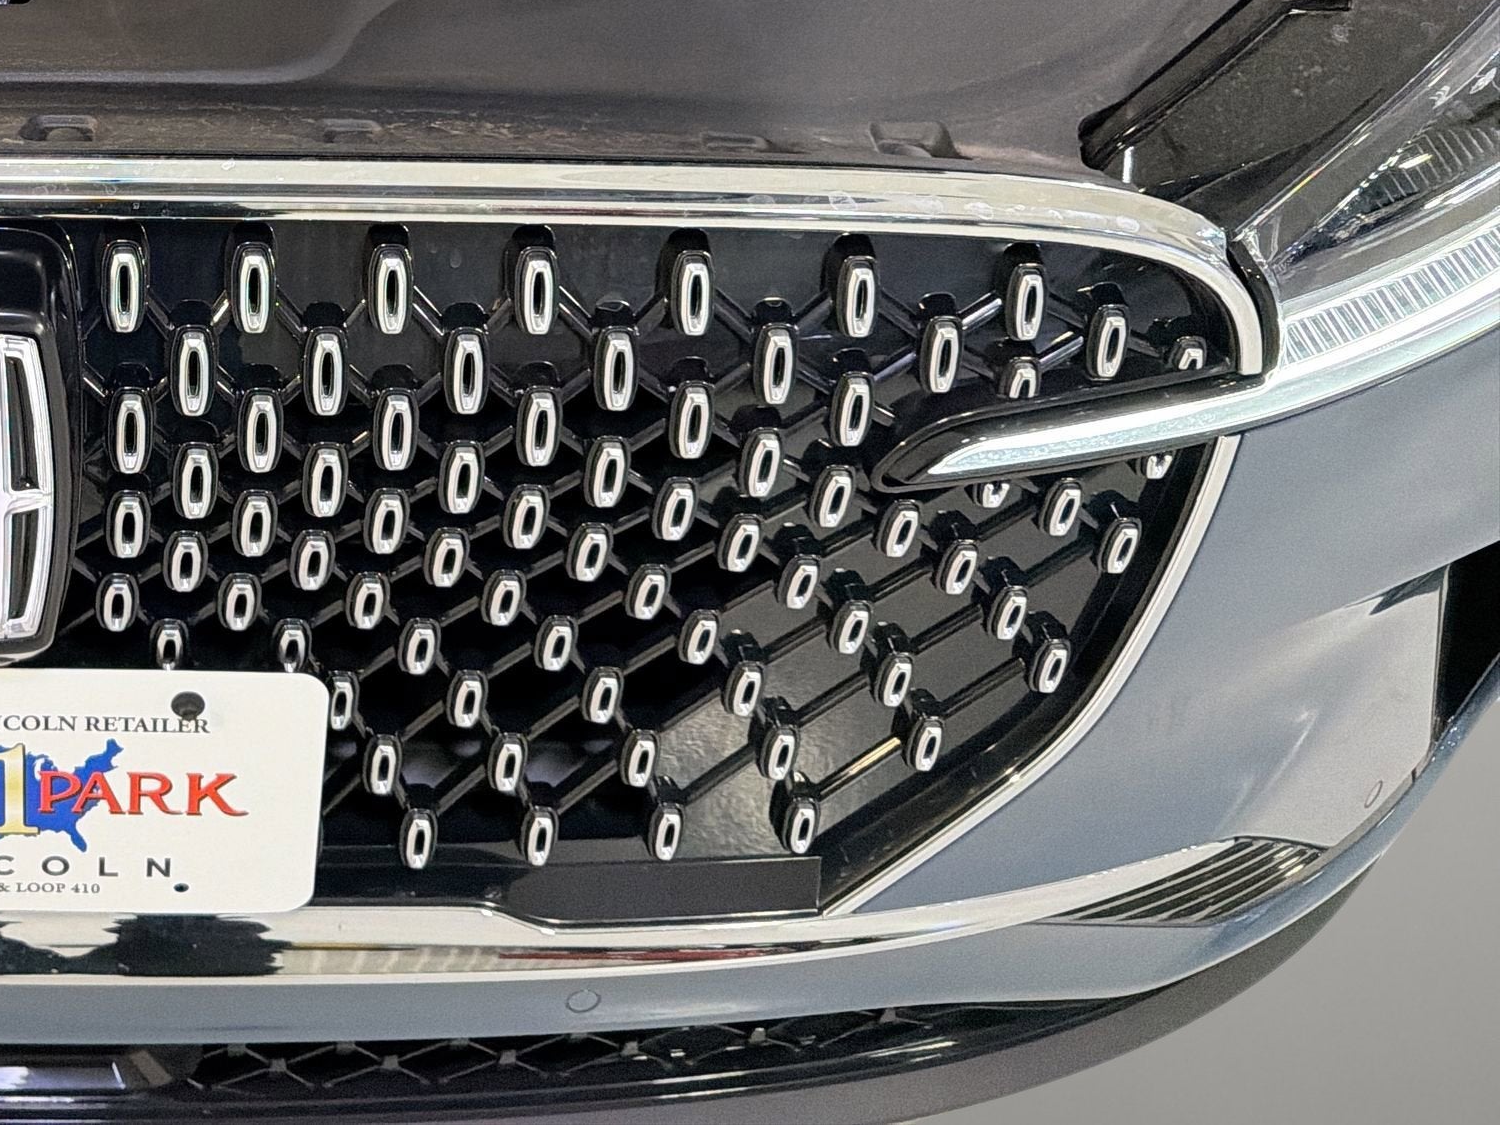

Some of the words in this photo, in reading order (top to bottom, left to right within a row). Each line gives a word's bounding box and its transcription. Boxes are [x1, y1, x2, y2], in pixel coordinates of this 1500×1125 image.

[84, 715, 210, 733] RETAILER
[38, 771, 249, 817] PARK
[16, 882, 65, 893] LOOP
[71, 883, 101, 894] 410
